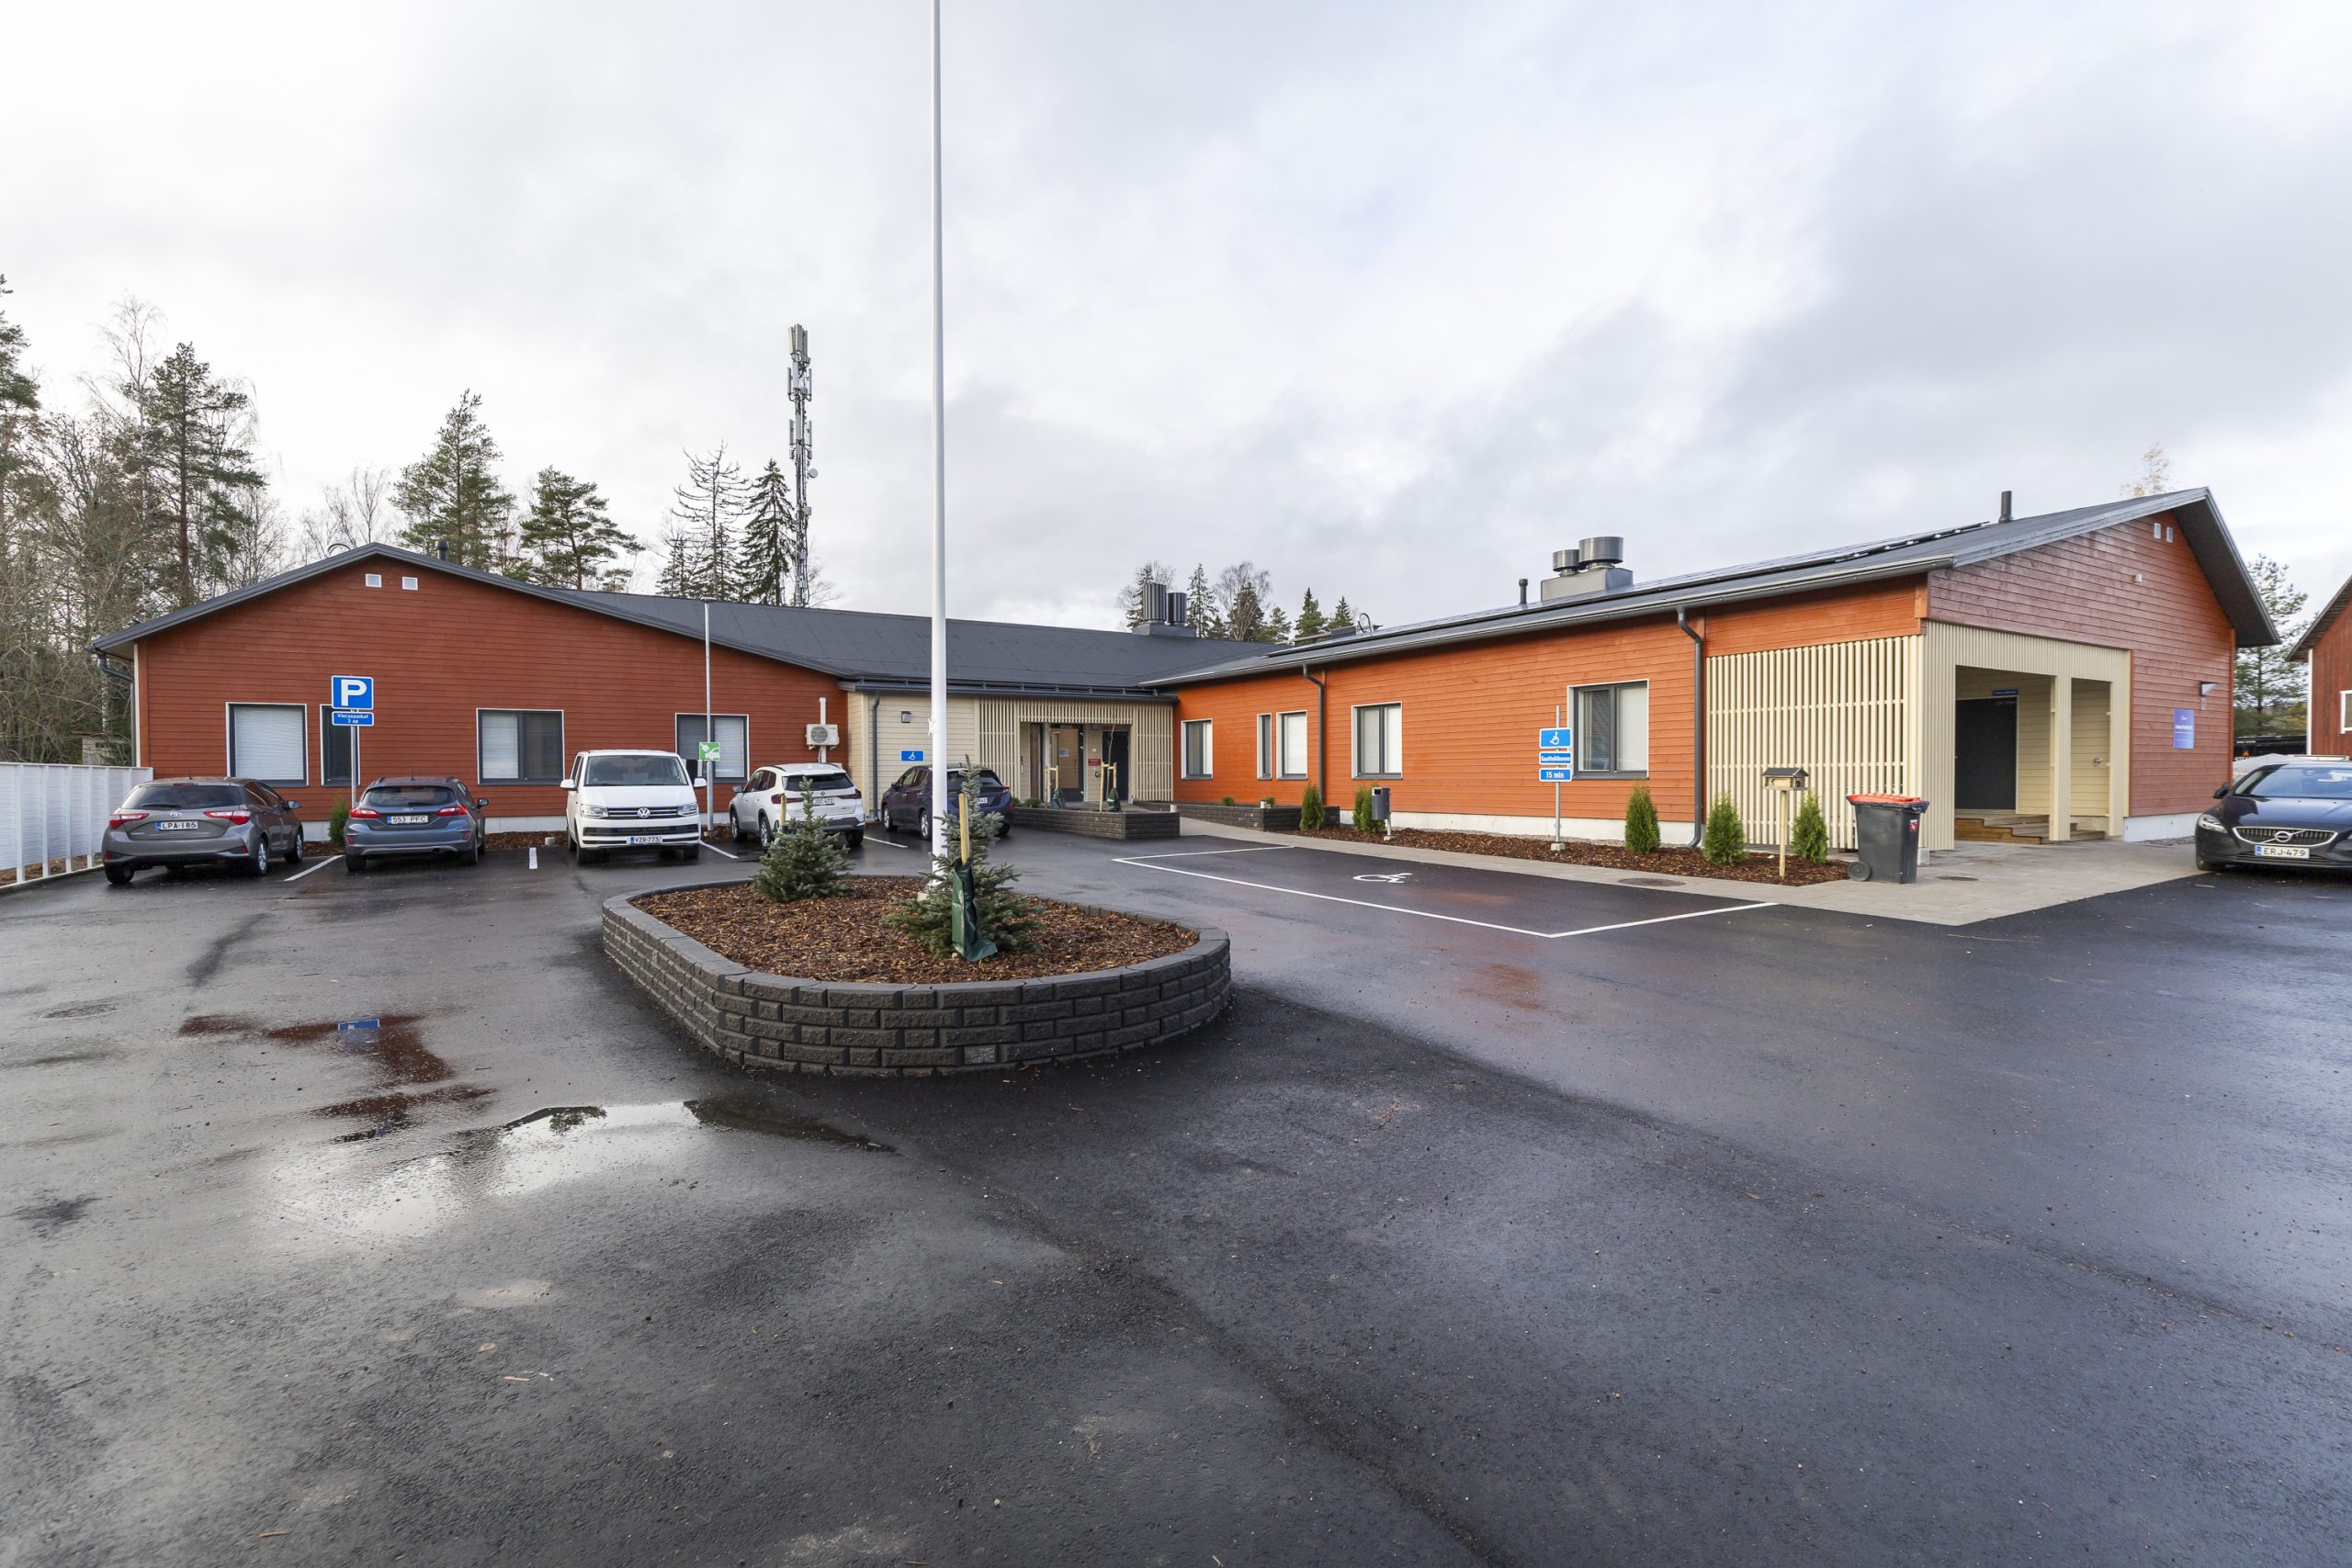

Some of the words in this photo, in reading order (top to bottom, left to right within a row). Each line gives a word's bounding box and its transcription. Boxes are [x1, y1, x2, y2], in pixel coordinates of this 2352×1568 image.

[341, 679, 368, 706] P
[1554, 771, 1565, 779] min
[162, 821, 197, 829] LPA-185
[2263, 847, 2306, 857] ERJ-479
